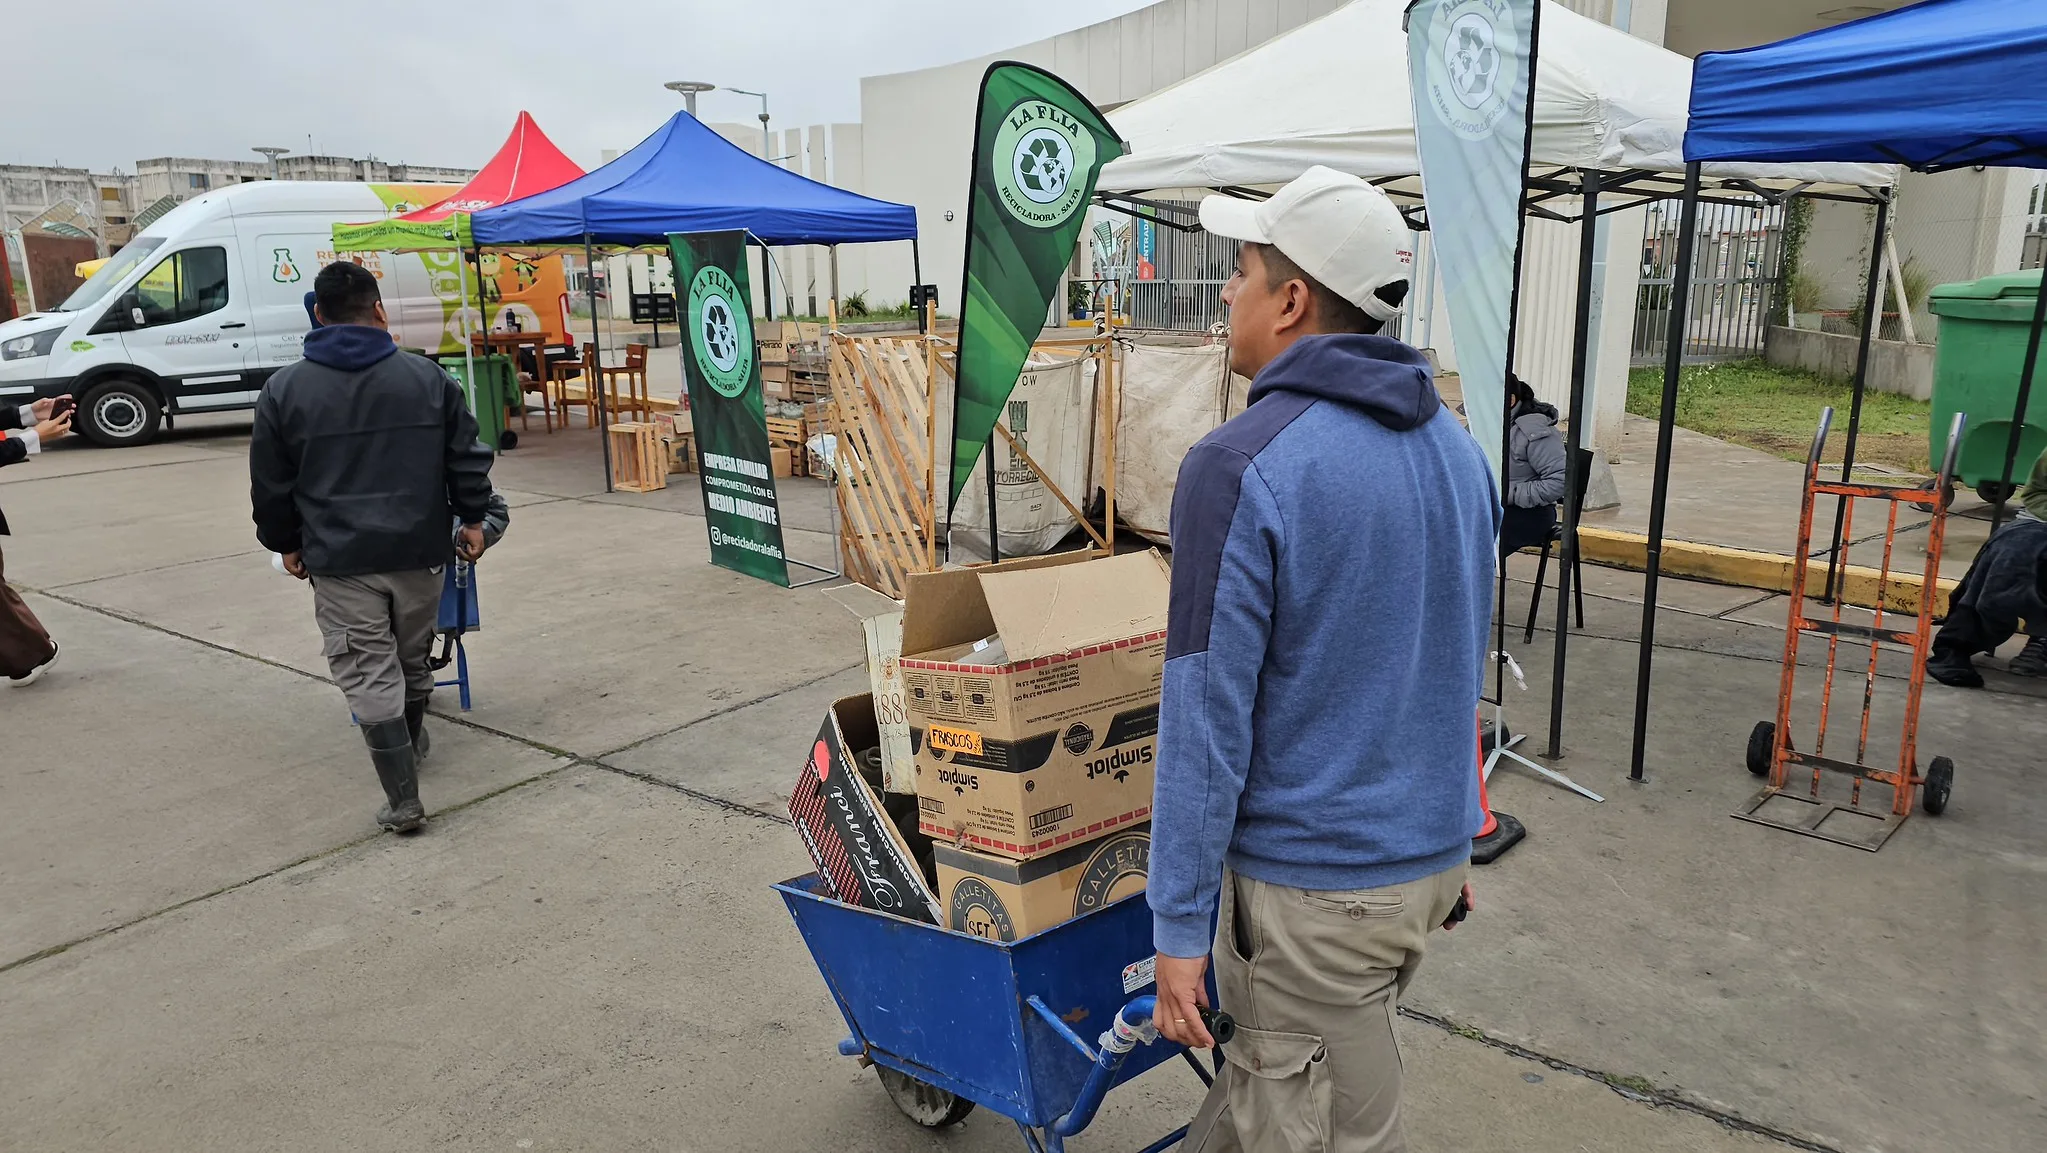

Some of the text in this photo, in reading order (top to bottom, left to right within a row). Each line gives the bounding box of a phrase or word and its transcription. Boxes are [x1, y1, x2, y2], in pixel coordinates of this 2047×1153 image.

[1010, 105, 1080, 138] LA FLIA
[1002, 186, 1057, 222] RECICLADORA
[1061, 188, 1080, 214] SALTA
[693, 270, 734, 302] LA FLIA
[760, 341, 783, 349] Peirano
[704, 452, 769, 480] EMPRESA FAMILIAR
[705, 475, 775, 500] COMPROMETIDA CON EL
[708, 491, 777, 526] MEDIO AMBIENTE
[874, 692, 909, 725] 188
[932, 729, 973, 750] FRASCOS
[1064, 731, 1093, 747] TRADICIONAL
[1084, 745, 1152, 780] Simplot
[938, 769, 979, 790] Simplot
[838, 752, 921, 897] PRODUCCION ARGENTINA
[1032, 824, 1060, 838] 10000243
[800, 817, 837, 892] RIO NEGRO
[954, 885, 1009, 932] GALLETITAS
